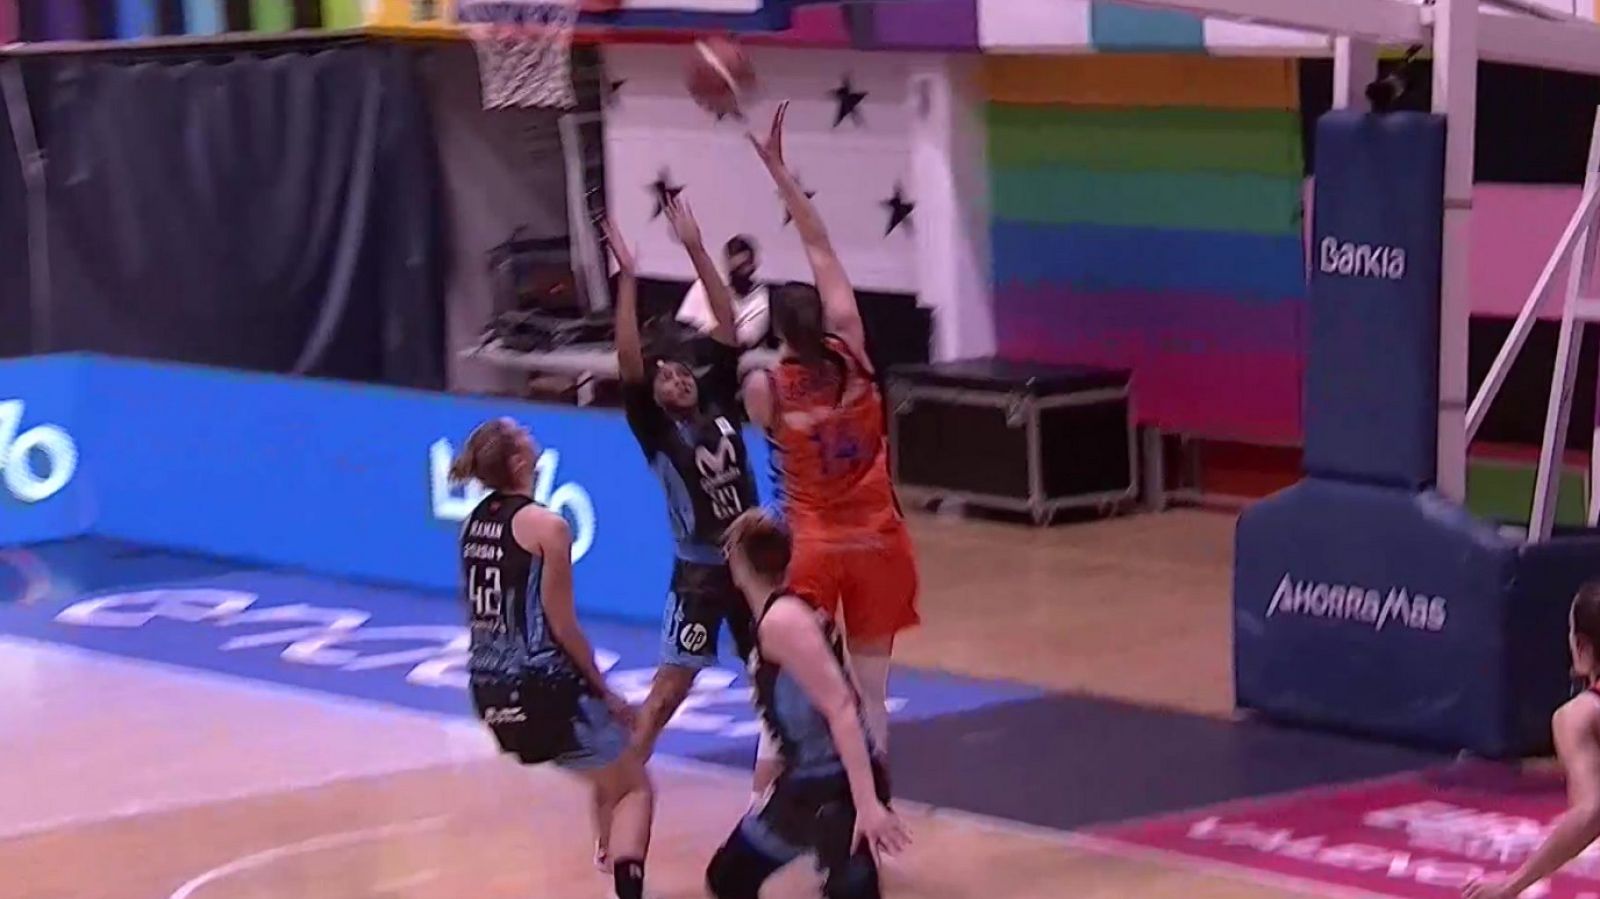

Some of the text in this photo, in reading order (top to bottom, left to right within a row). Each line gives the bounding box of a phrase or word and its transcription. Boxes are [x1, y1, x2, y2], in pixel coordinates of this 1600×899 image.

[1320, 236, 1406, 280] Bankia
[469, 565, 502, 616] 42
[680, 622, 707, 652] hp
